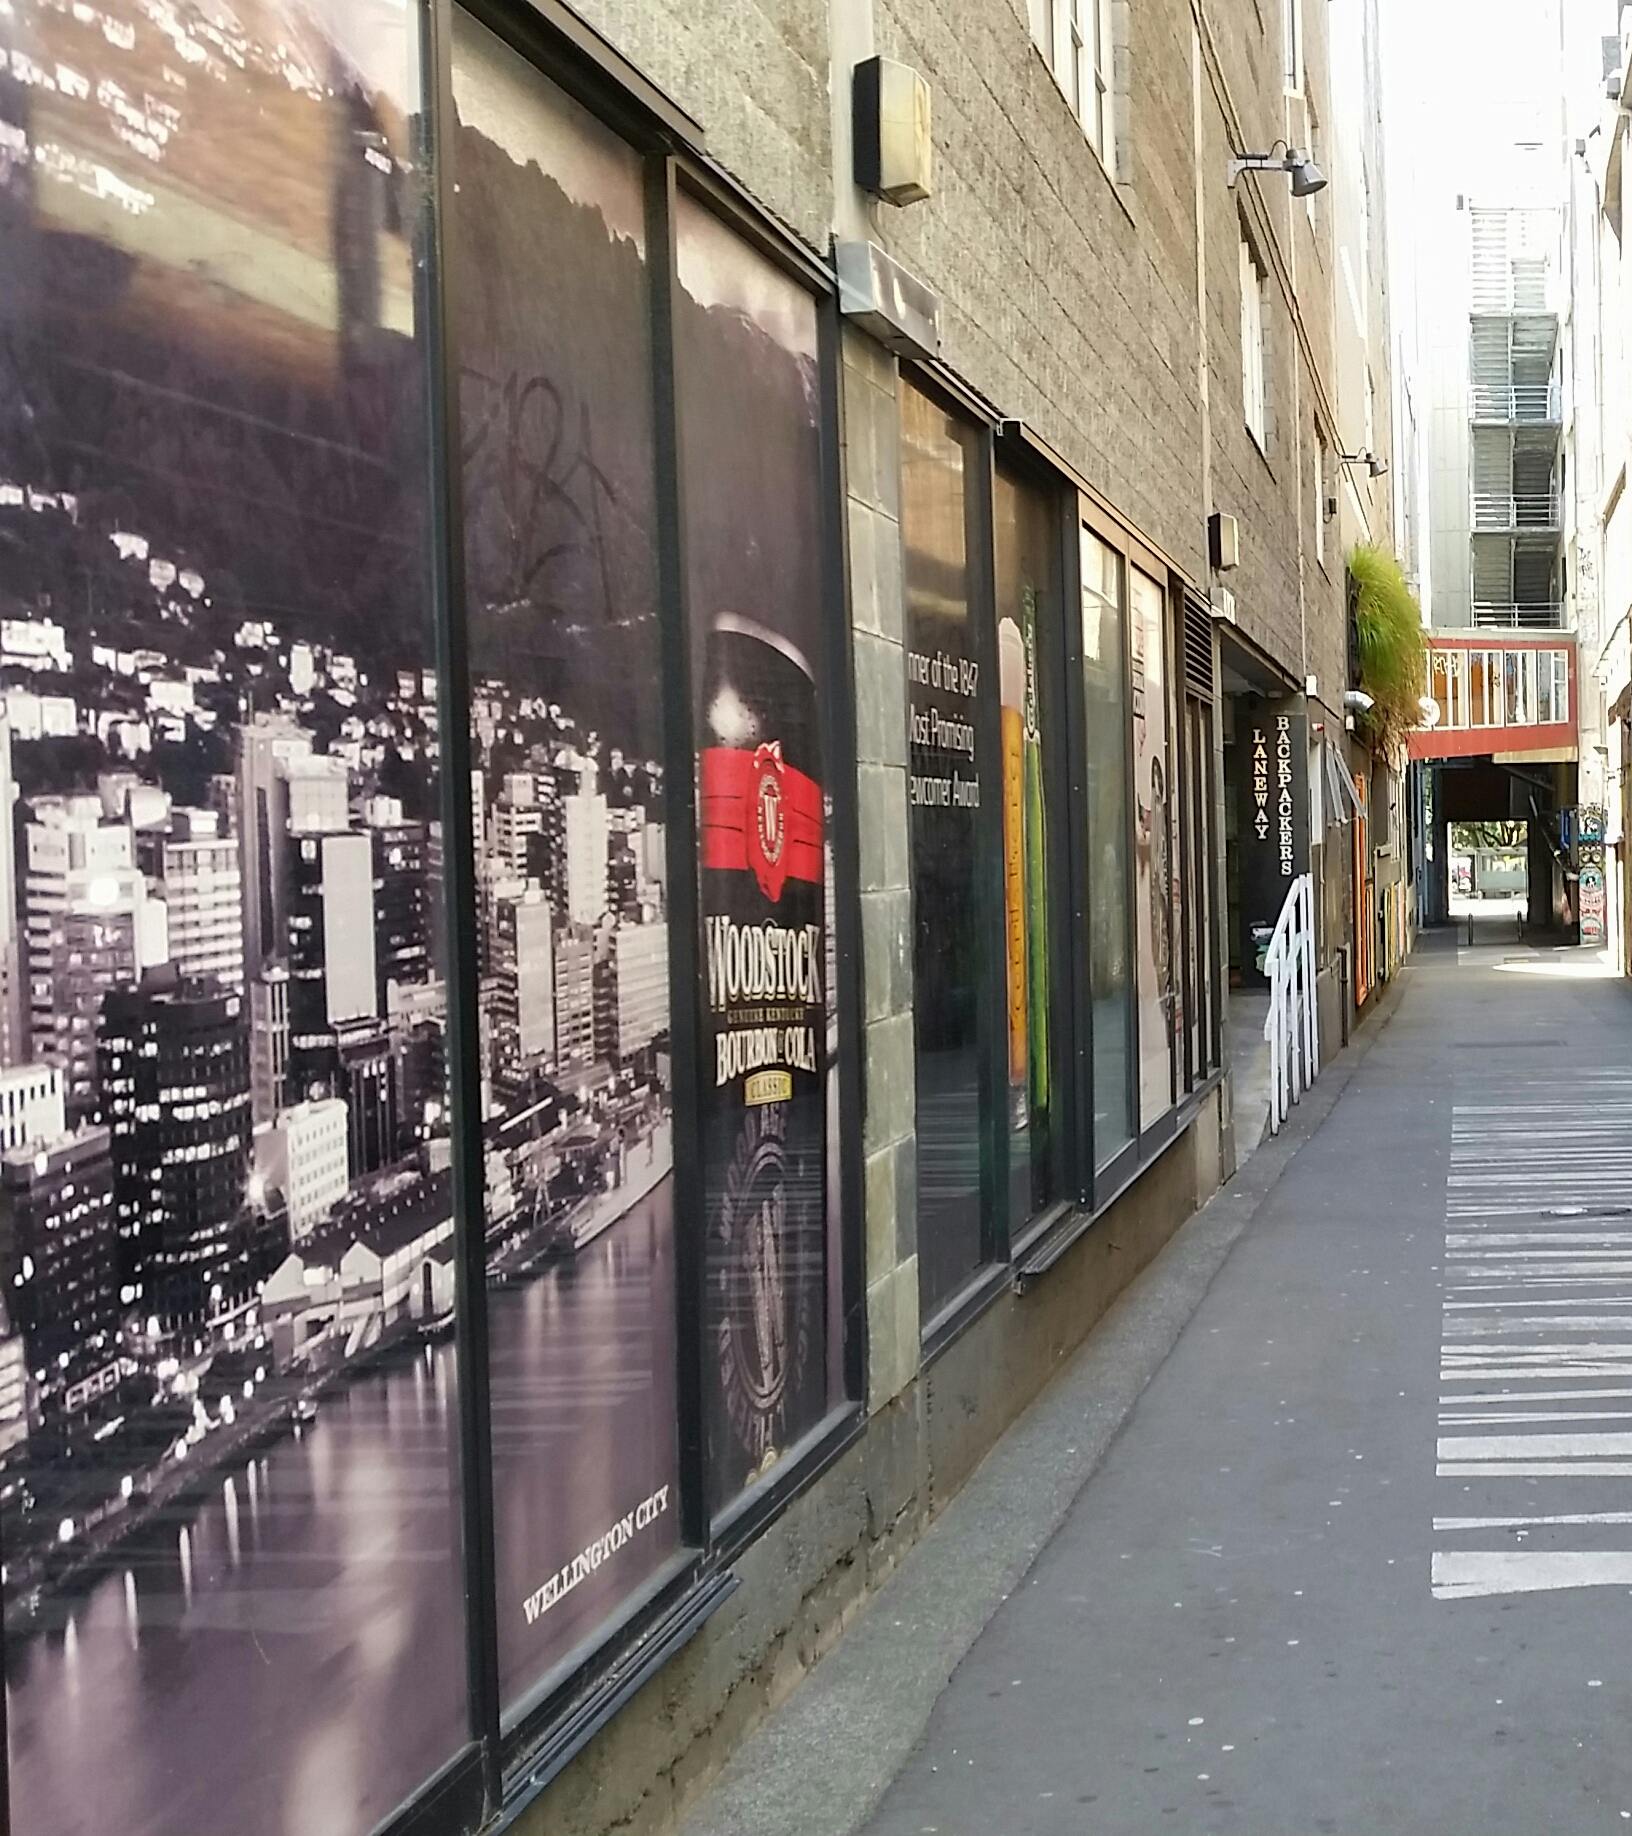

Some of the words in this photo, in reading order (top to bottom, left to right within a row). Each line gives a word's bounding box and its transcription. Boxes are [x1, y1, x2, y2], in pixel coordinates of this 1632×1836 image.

[931, 650, 943, 688] of
[943, 654, 959, 694] the
[931, 707, 974, 762] Promising
[953, 769, 980, 808] Award
[1253, 729, 1269, 839] LANEWAY
[1276, 716, 1293, 875] BACKPACKERS
[705, 915, 822, 1012] WOODSTOCK
[716, 1027, 778, 1087] BOURBON
[784, 1026, 816, 1073] COLA
[750, 1076, 787, 1099] CLASSIC
[523, 1511, 633, 1625] WELLINGTON
[636, 1484, 669, 1530] CITY
